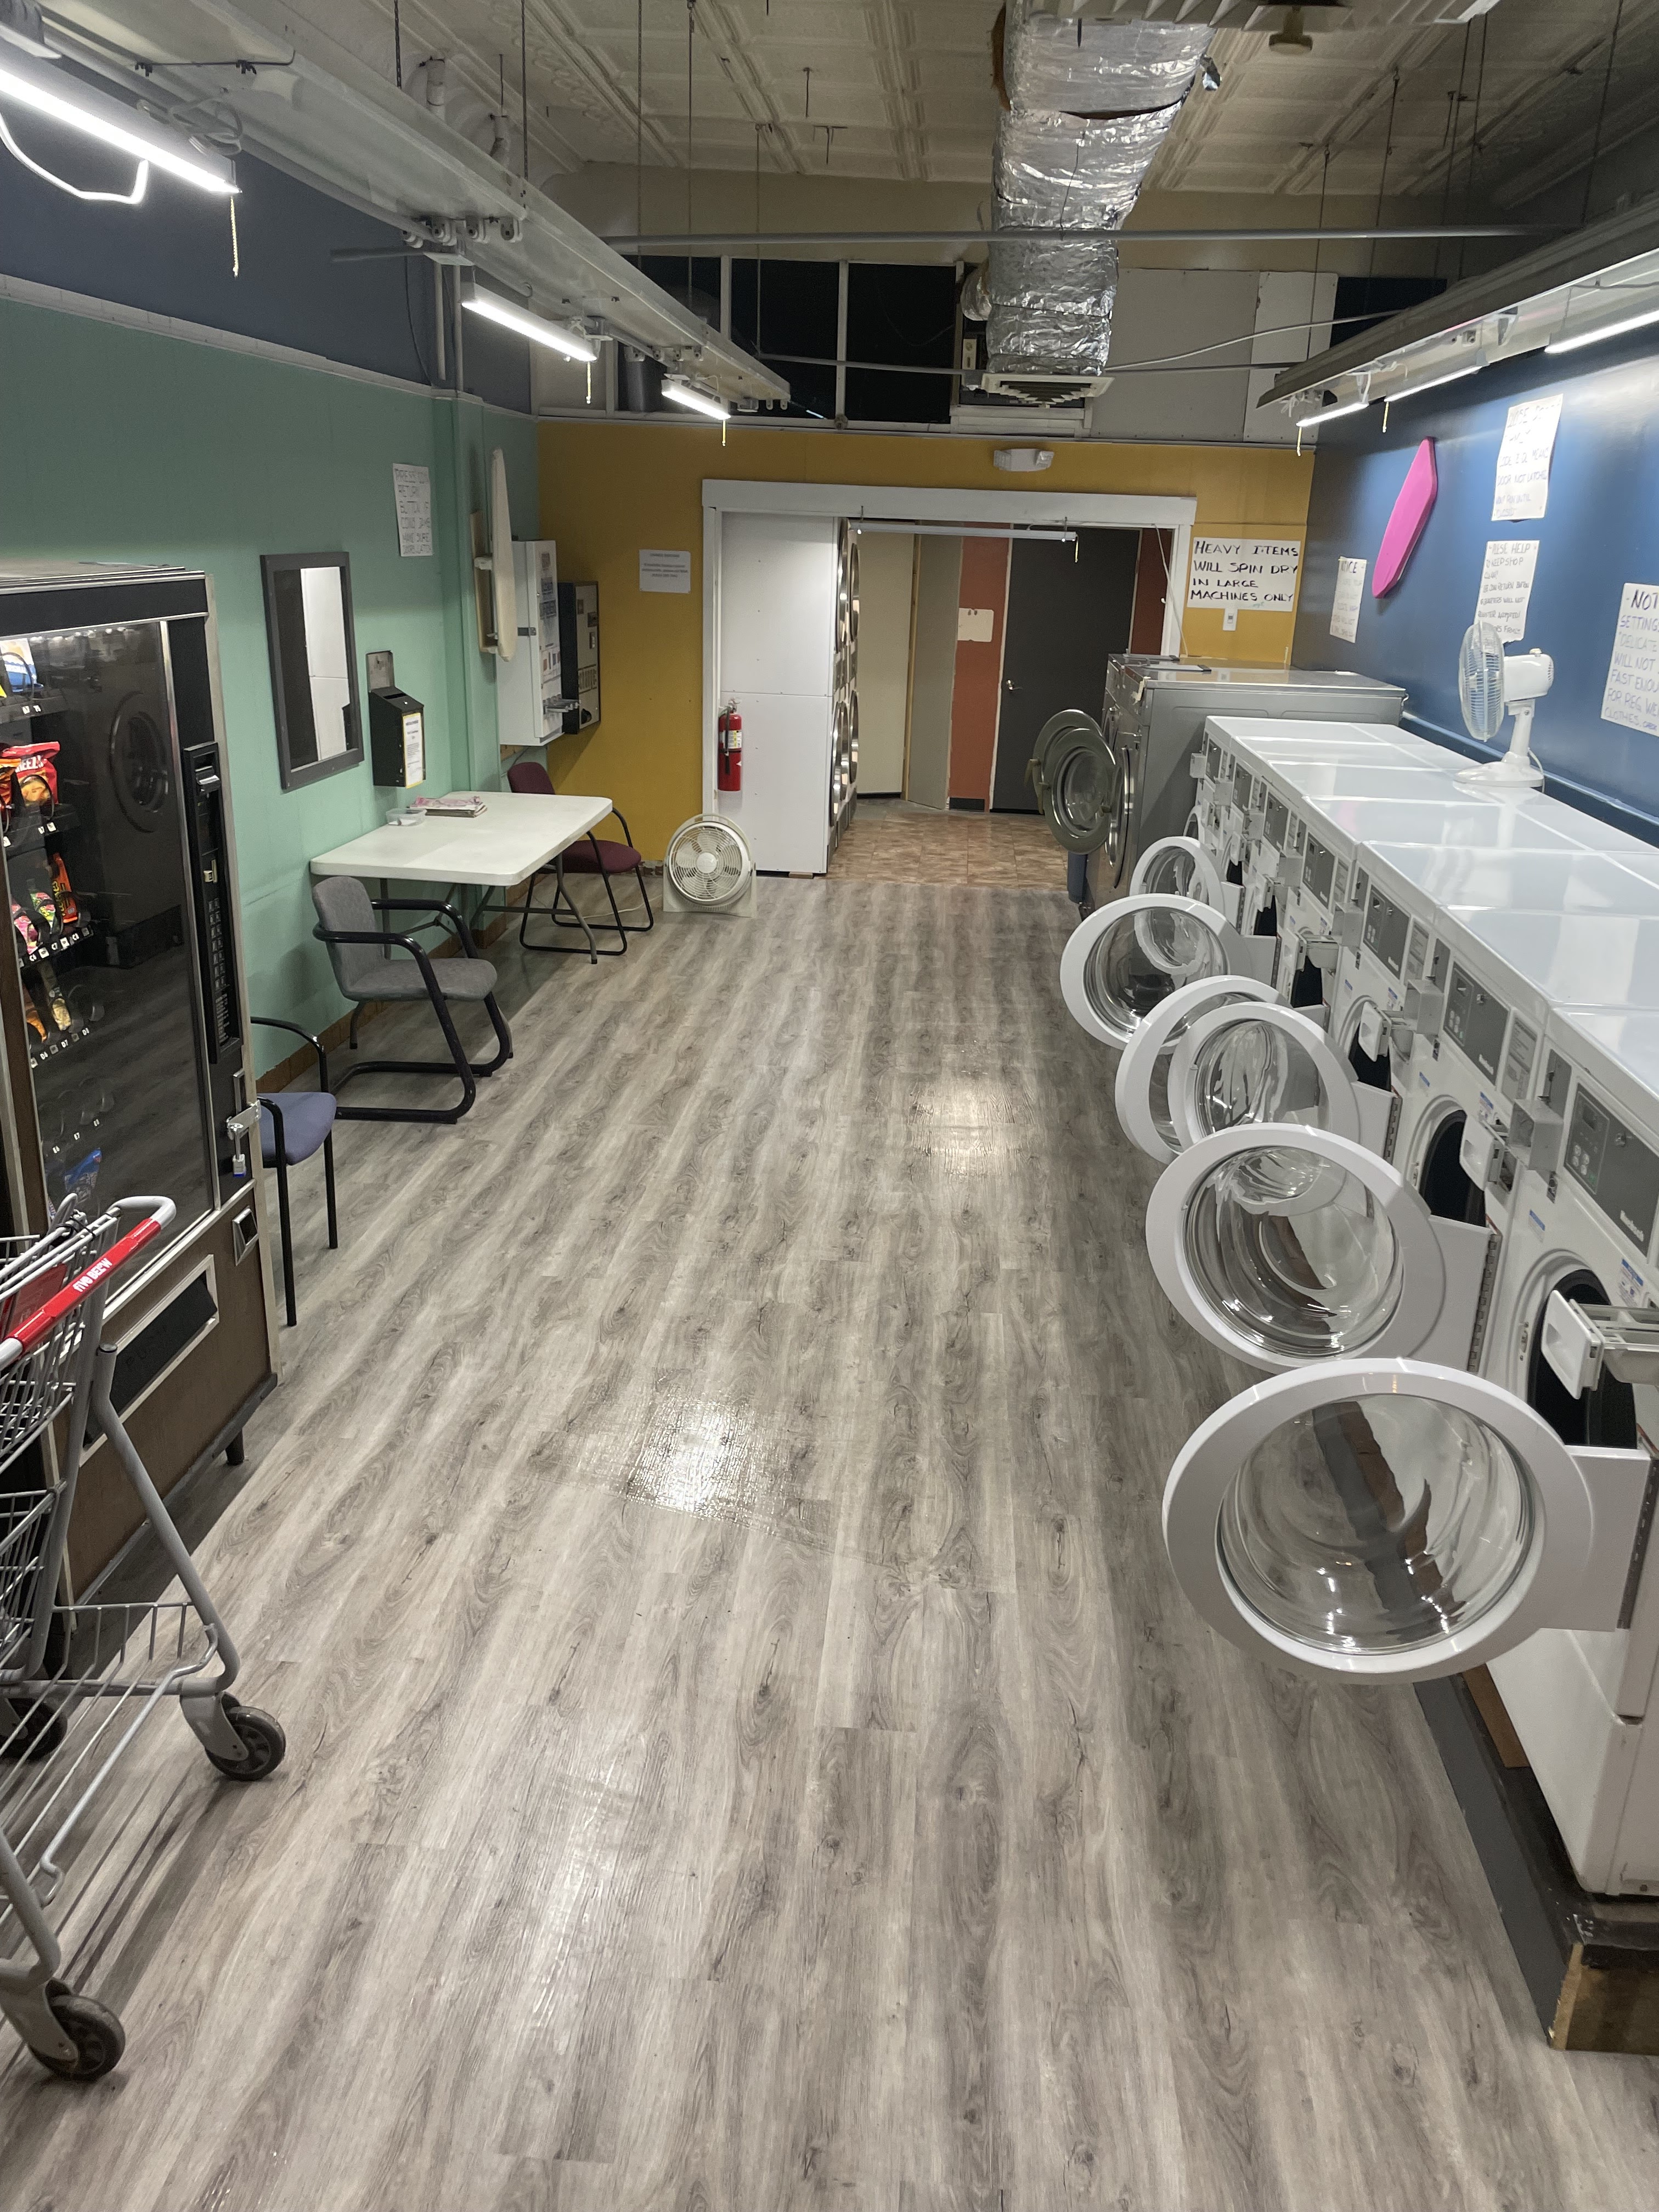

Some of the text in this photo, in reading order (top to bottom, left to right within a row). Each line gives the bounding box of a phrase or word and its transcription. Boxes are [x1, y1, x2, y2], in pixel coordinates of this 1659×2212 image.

[1194, 540, 1299, 556] HEAVY ITEMS
[1510, 542, 1531, 555] HELP
[1193, 560, 1299, 574] WILL SPIN DRY
[1505, 556, 1524, 567] SHOP
[1193, 578, 1259, 588] IN LARGE
[1190, 590, 1294, 602] MACHINES ONLY
[1614, 652, 1656, 672] WILL NOT
[1610, 669, 1635, 686] FAST
[86, 1257, 113, 1280] BELOW
